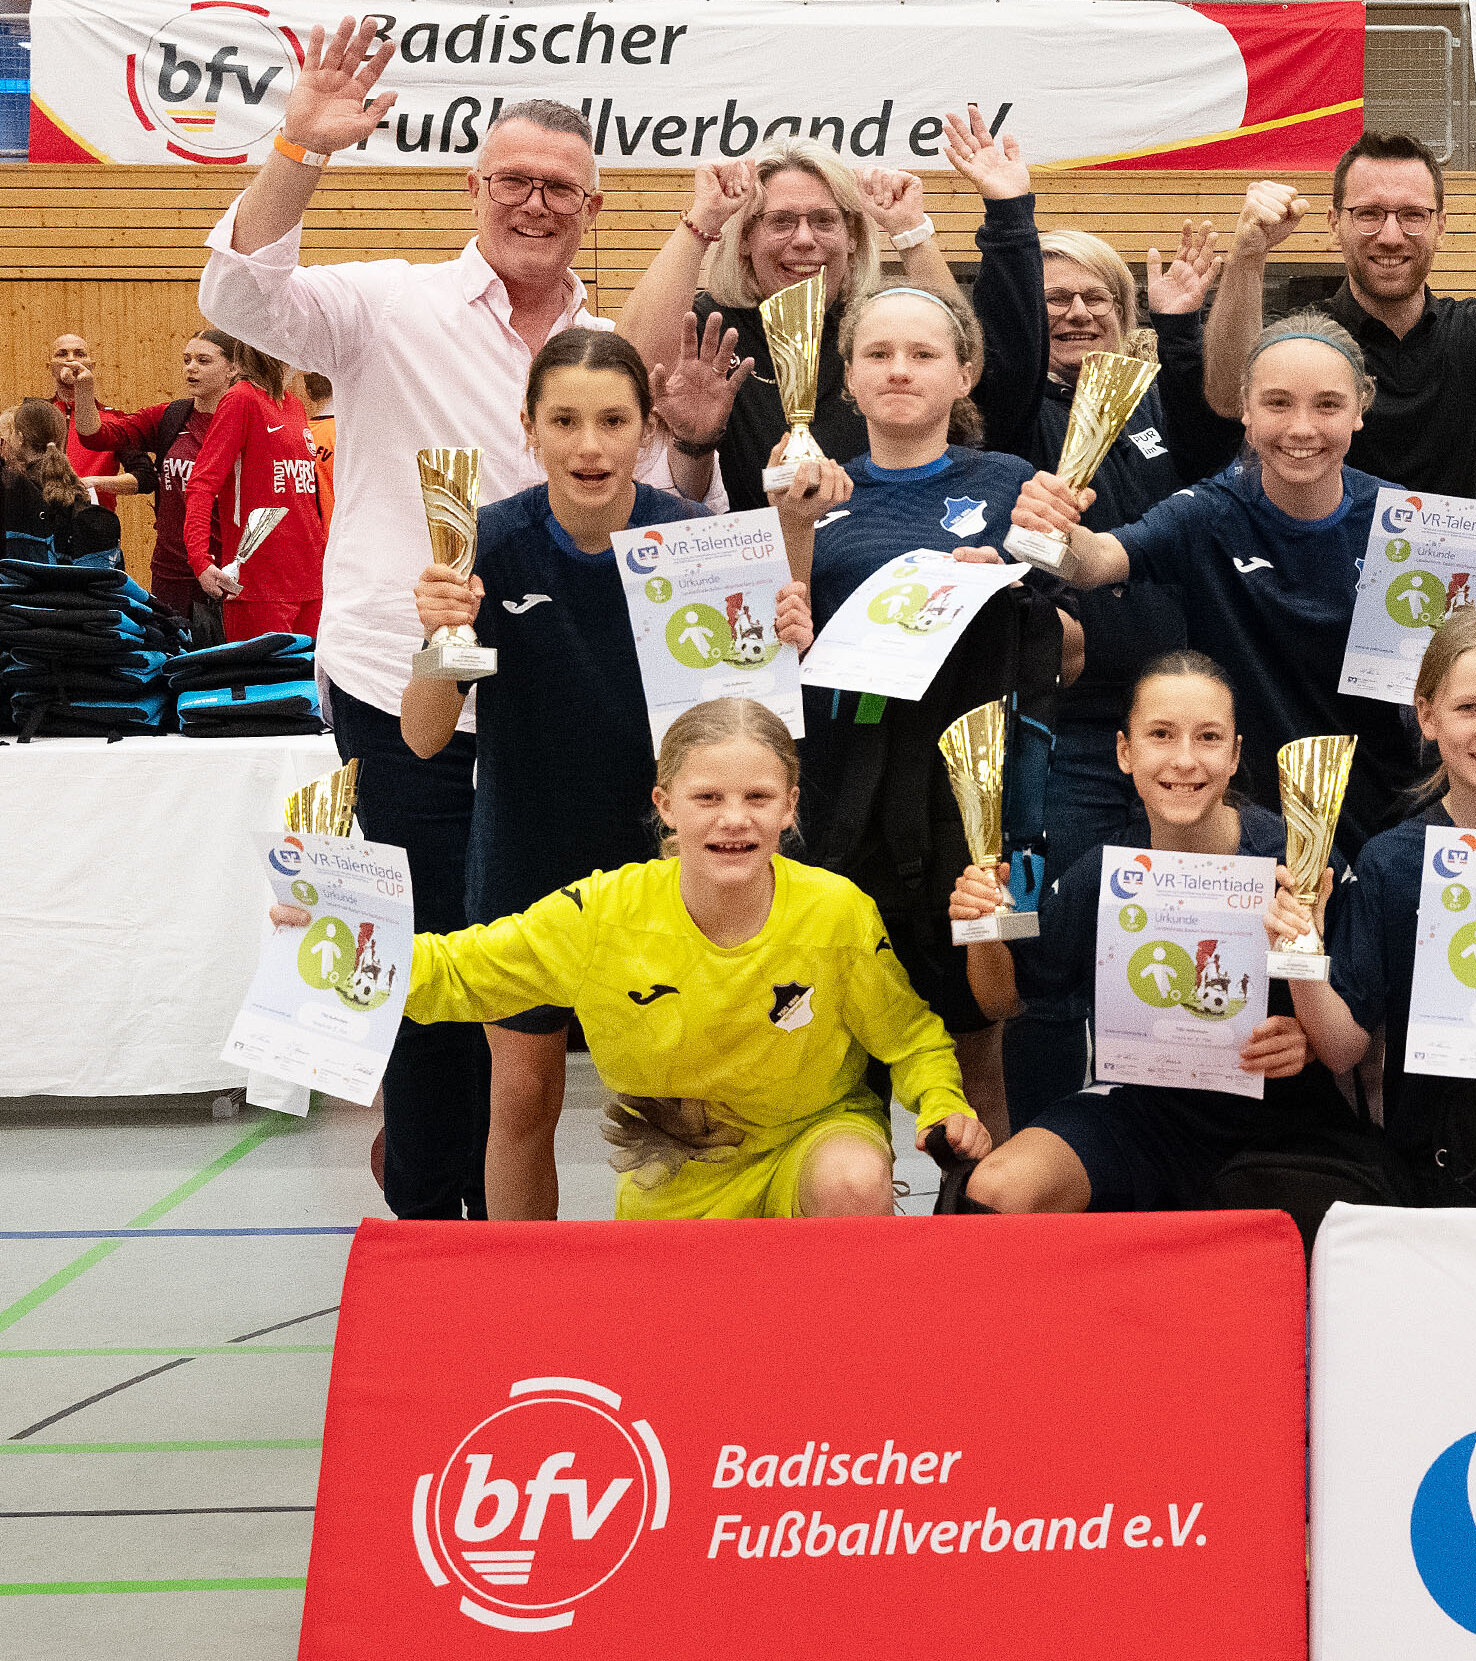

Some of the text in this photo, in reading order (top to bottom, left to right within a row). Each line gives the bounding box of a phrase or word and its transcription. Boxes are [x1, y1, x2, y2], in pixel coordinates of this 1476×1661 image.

[156, 41, 284, 106] bfv
[273, 460, 286, 494] STADT
[665, 528, 773, 557] VR-Talentiade
[742, 544, 775, 562] CUP
[306, 851, 403, 881] VR-Talentiade
[375, 879, 405, 898] CUP
[1152, 872, 1264, 894] VR-Talentiade
[1226, 894, 1263, 910] CUP
[712, 1439, 962, 1489] Badischer
[454, 1451, 634, 1542] bfv
[707, 1501, 1208, 1559] Fußballverband e.V.
